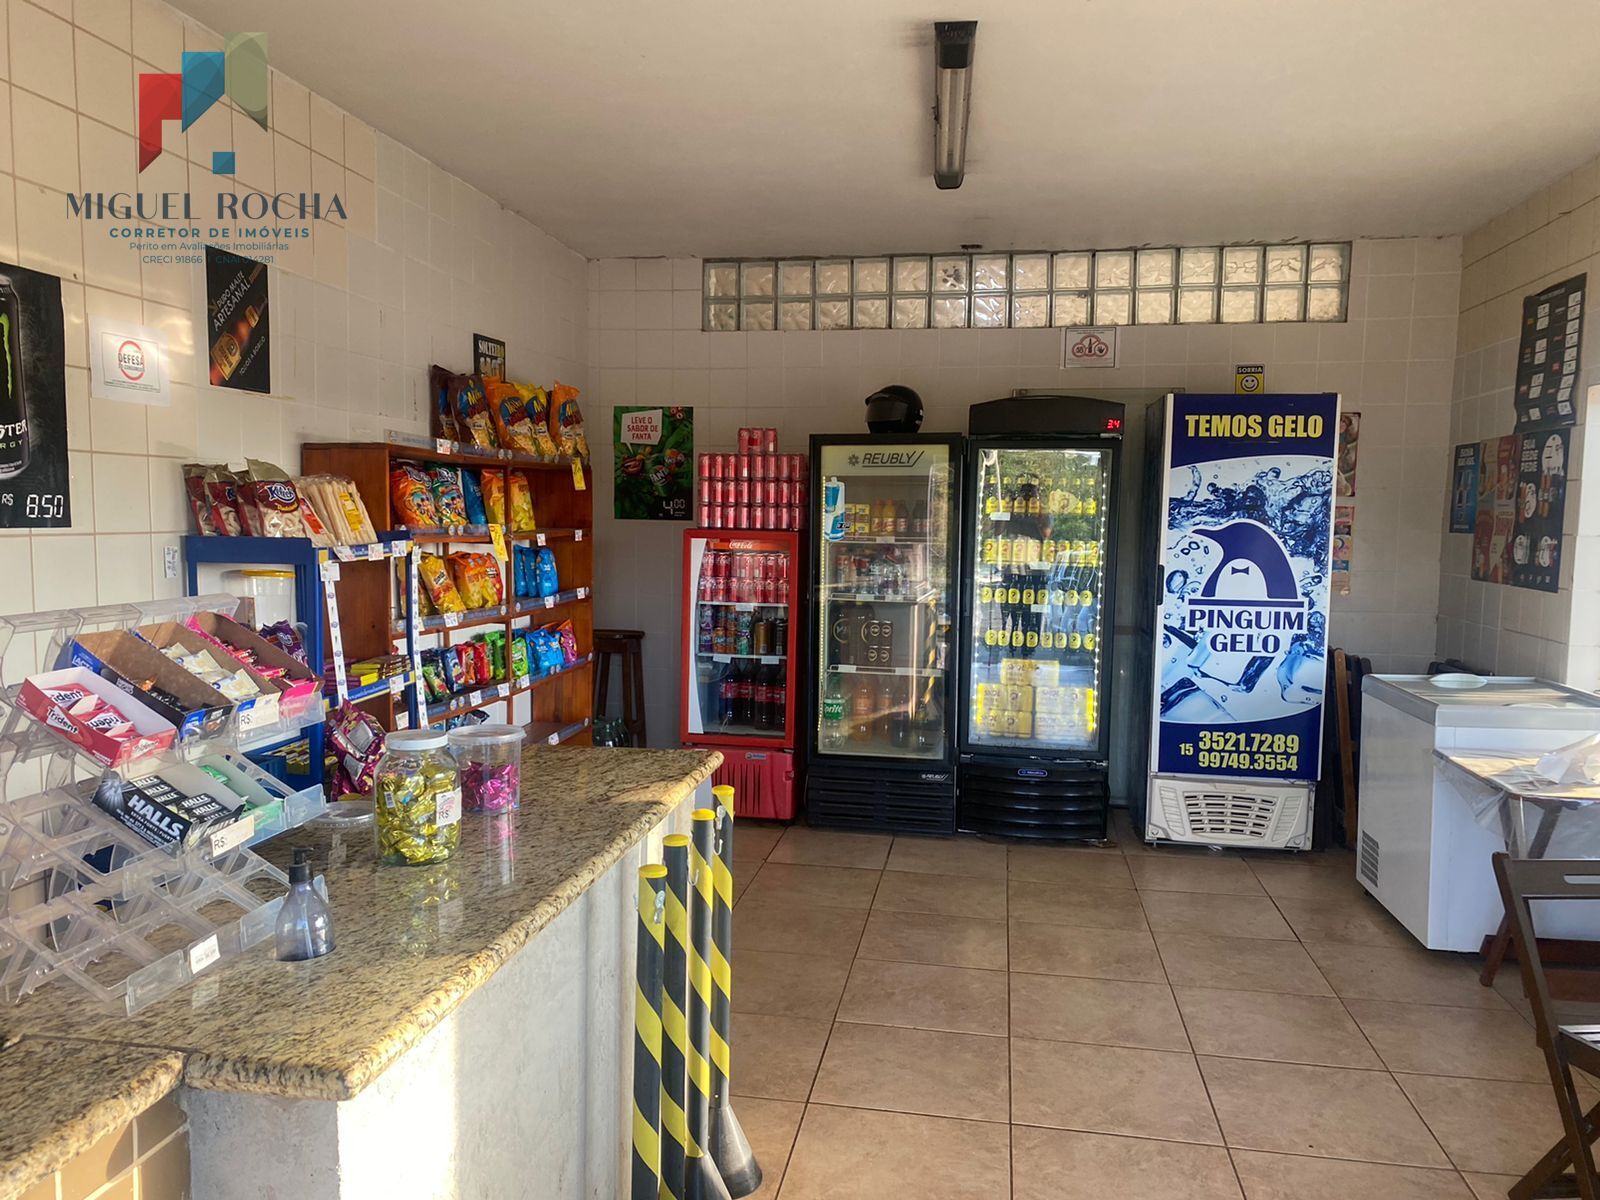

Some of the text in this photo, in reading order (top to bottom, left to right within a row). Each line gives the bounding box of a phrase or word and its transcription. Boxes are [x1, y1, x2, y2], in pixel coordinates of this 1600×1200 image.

[118, 352, 144, 366] DEFESA
[0, 419, 28, 439] STER
[627, 424, 648, 433] SABOR
[1185, 414, 1323, 438] TEMOS GELO
[0, 440, 22, 449] RGY
[862, 451, 917, 465] REUBLY
[26, 494, 64, 518] 8.50
[1188, 609, 1304, 630] PINGUIM
[1210, 633, 1280, 653] GELO
[51, 690, 84, 704] ident
[824, 704, 842, 714] prite
[47, 706, 79, 735] Trident
[87, 715, 123, 730] riden
[1179, 743, 1194, 756] 15
[1198, 731, 1299, 754] 3521.7289
[1198, 752, 1298, 771] 99749.3554
[181, 794, 211, 808] HALLS
[127, 794, 184, 838] HALLS
[192, 802, 219, 816] HALLS
